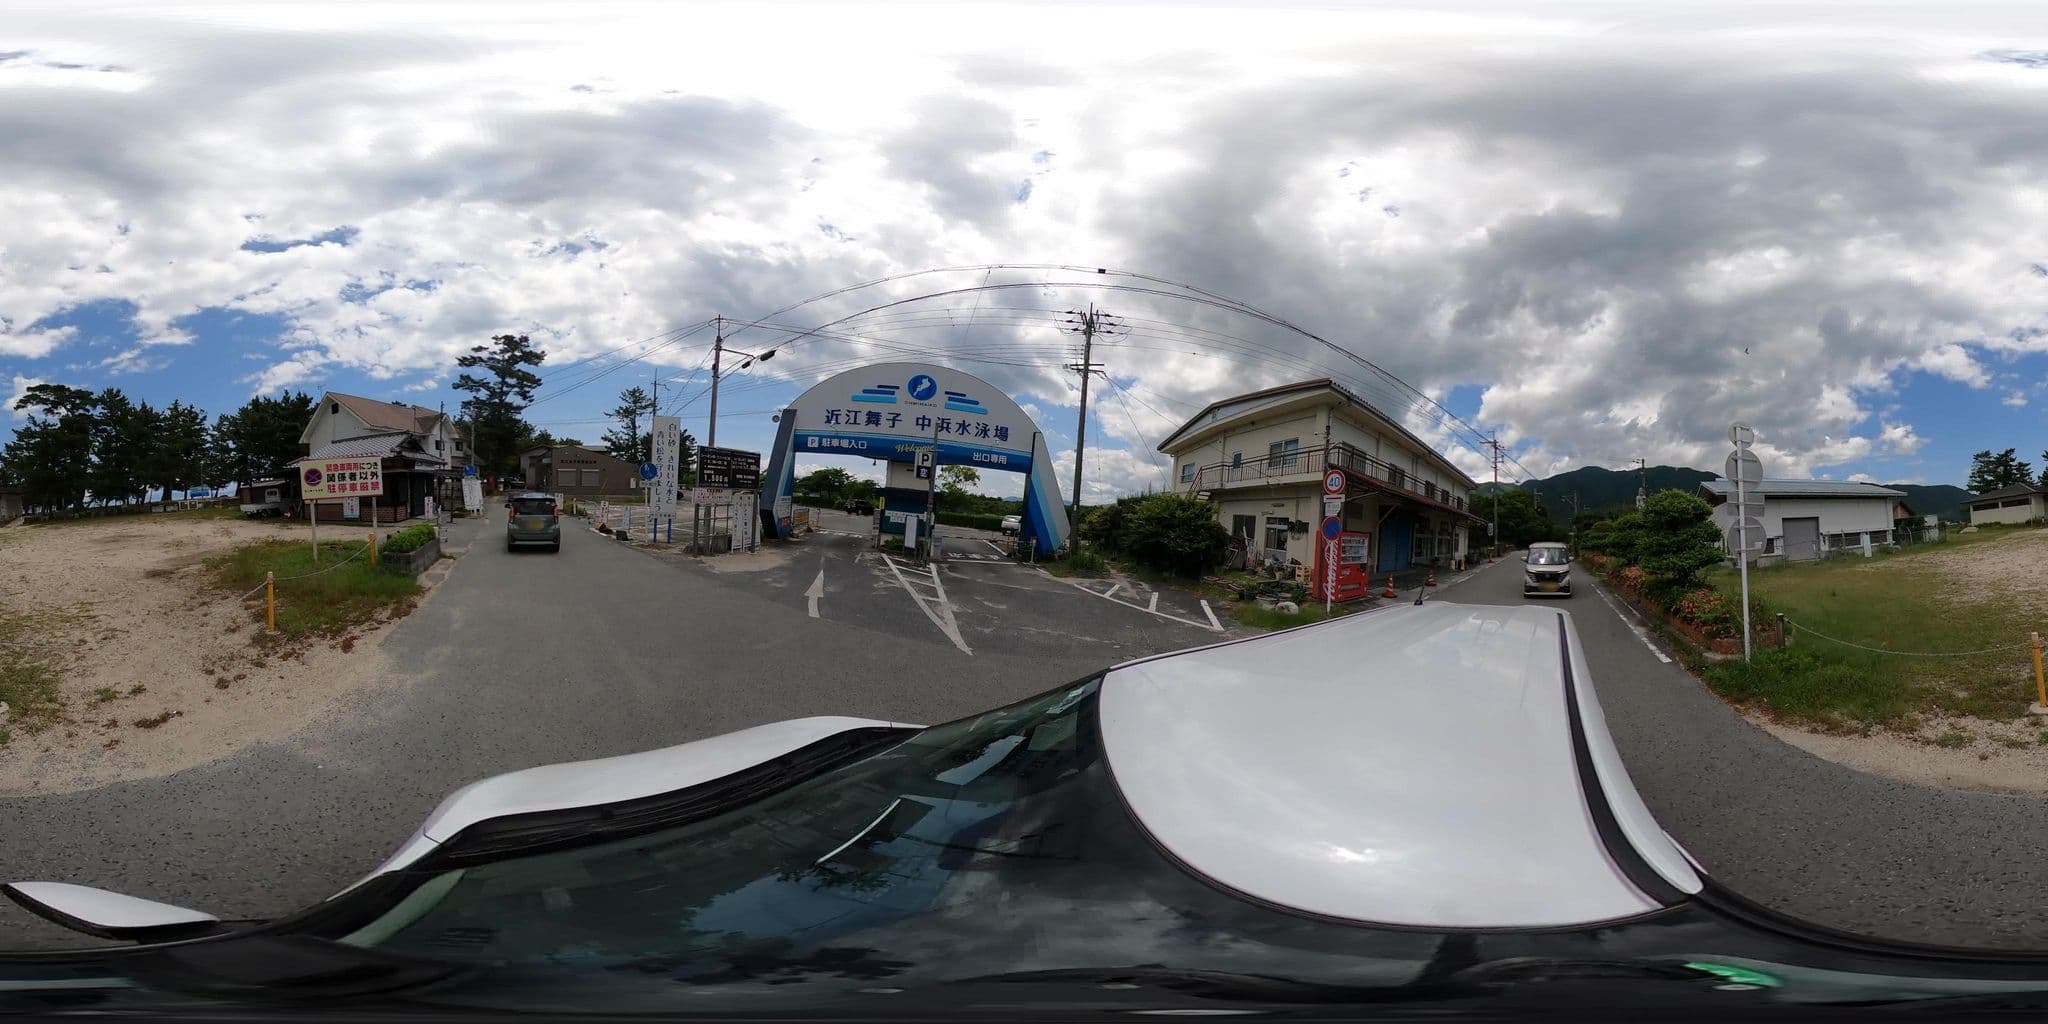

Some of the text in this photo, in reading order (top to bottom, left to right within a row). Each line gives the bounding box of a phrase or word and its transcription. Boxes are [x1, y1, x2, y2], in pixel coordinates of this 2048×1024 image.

[824, 408, 1009, 441] 近江舞子 中浜水泳場
[822, 438, 867, 449] 駐車場入口
[922, 453, 930, 465] P
[972, 452, 1007, 464] 出口専用
[1328, 476, 1341, 487] 40
